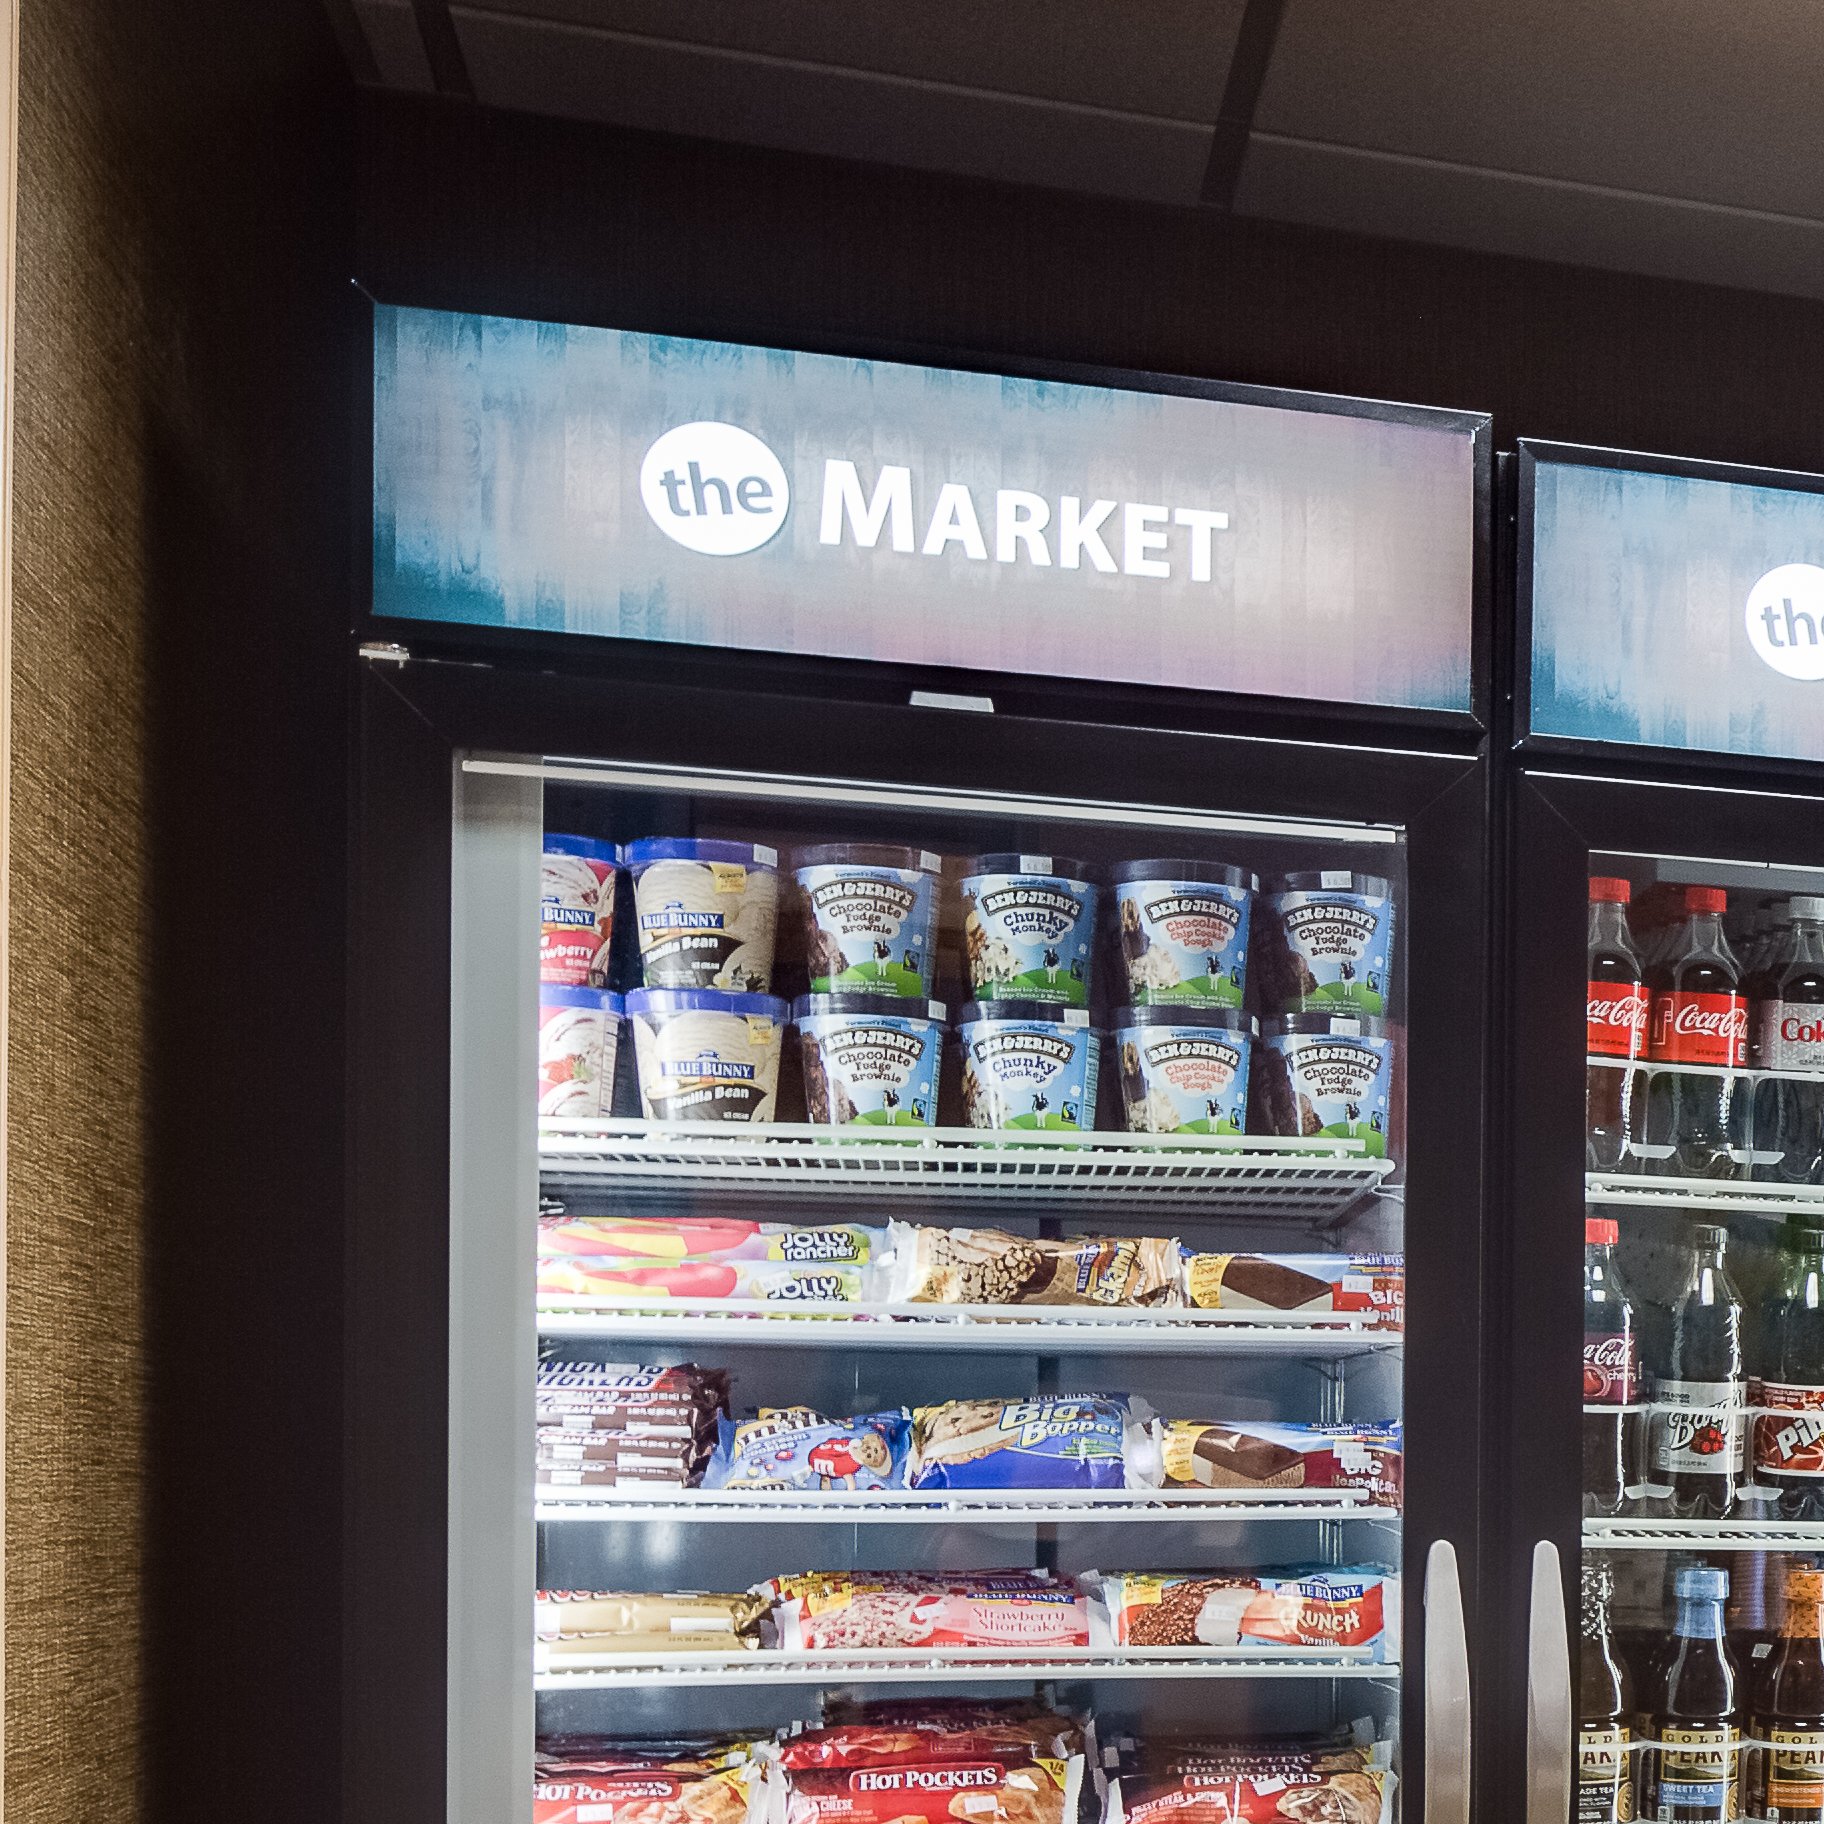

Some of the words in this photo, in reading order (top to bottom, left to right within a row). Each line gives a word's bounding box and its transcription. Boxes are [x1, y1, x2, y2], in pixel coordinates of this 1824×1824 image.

[659, 461, 774, 517] the
[820, 459, 1229, 582] MARKET
[1004, 911, 1069, 932] Chunky
[1011, 924, 1058, 940] Monkey
[1299, 925, 1365, 942] Chocolate
[1315, 936, 1347, 947] Fudge
[1311, 945, 1357, 958] Brownie
[780, 1231, 849, 1250] JOLLY
[786, 1242, 859, 1262] rancher
[1000, 1403, 1081, 1432] Big
[1020, 1418, 1120, 1448] Bopper
[972, 1606, 1064, 1623] Strawberry
[1279, 1606, 1359, 1633] CRUNCH
[979, 1619, 1064, 1634] Shortcake
[859, 1772, 901, 1791] HOT
[906, 1768, 997, 1791] POCKETS
[1694, 1785, 1714, 1794] TEA
